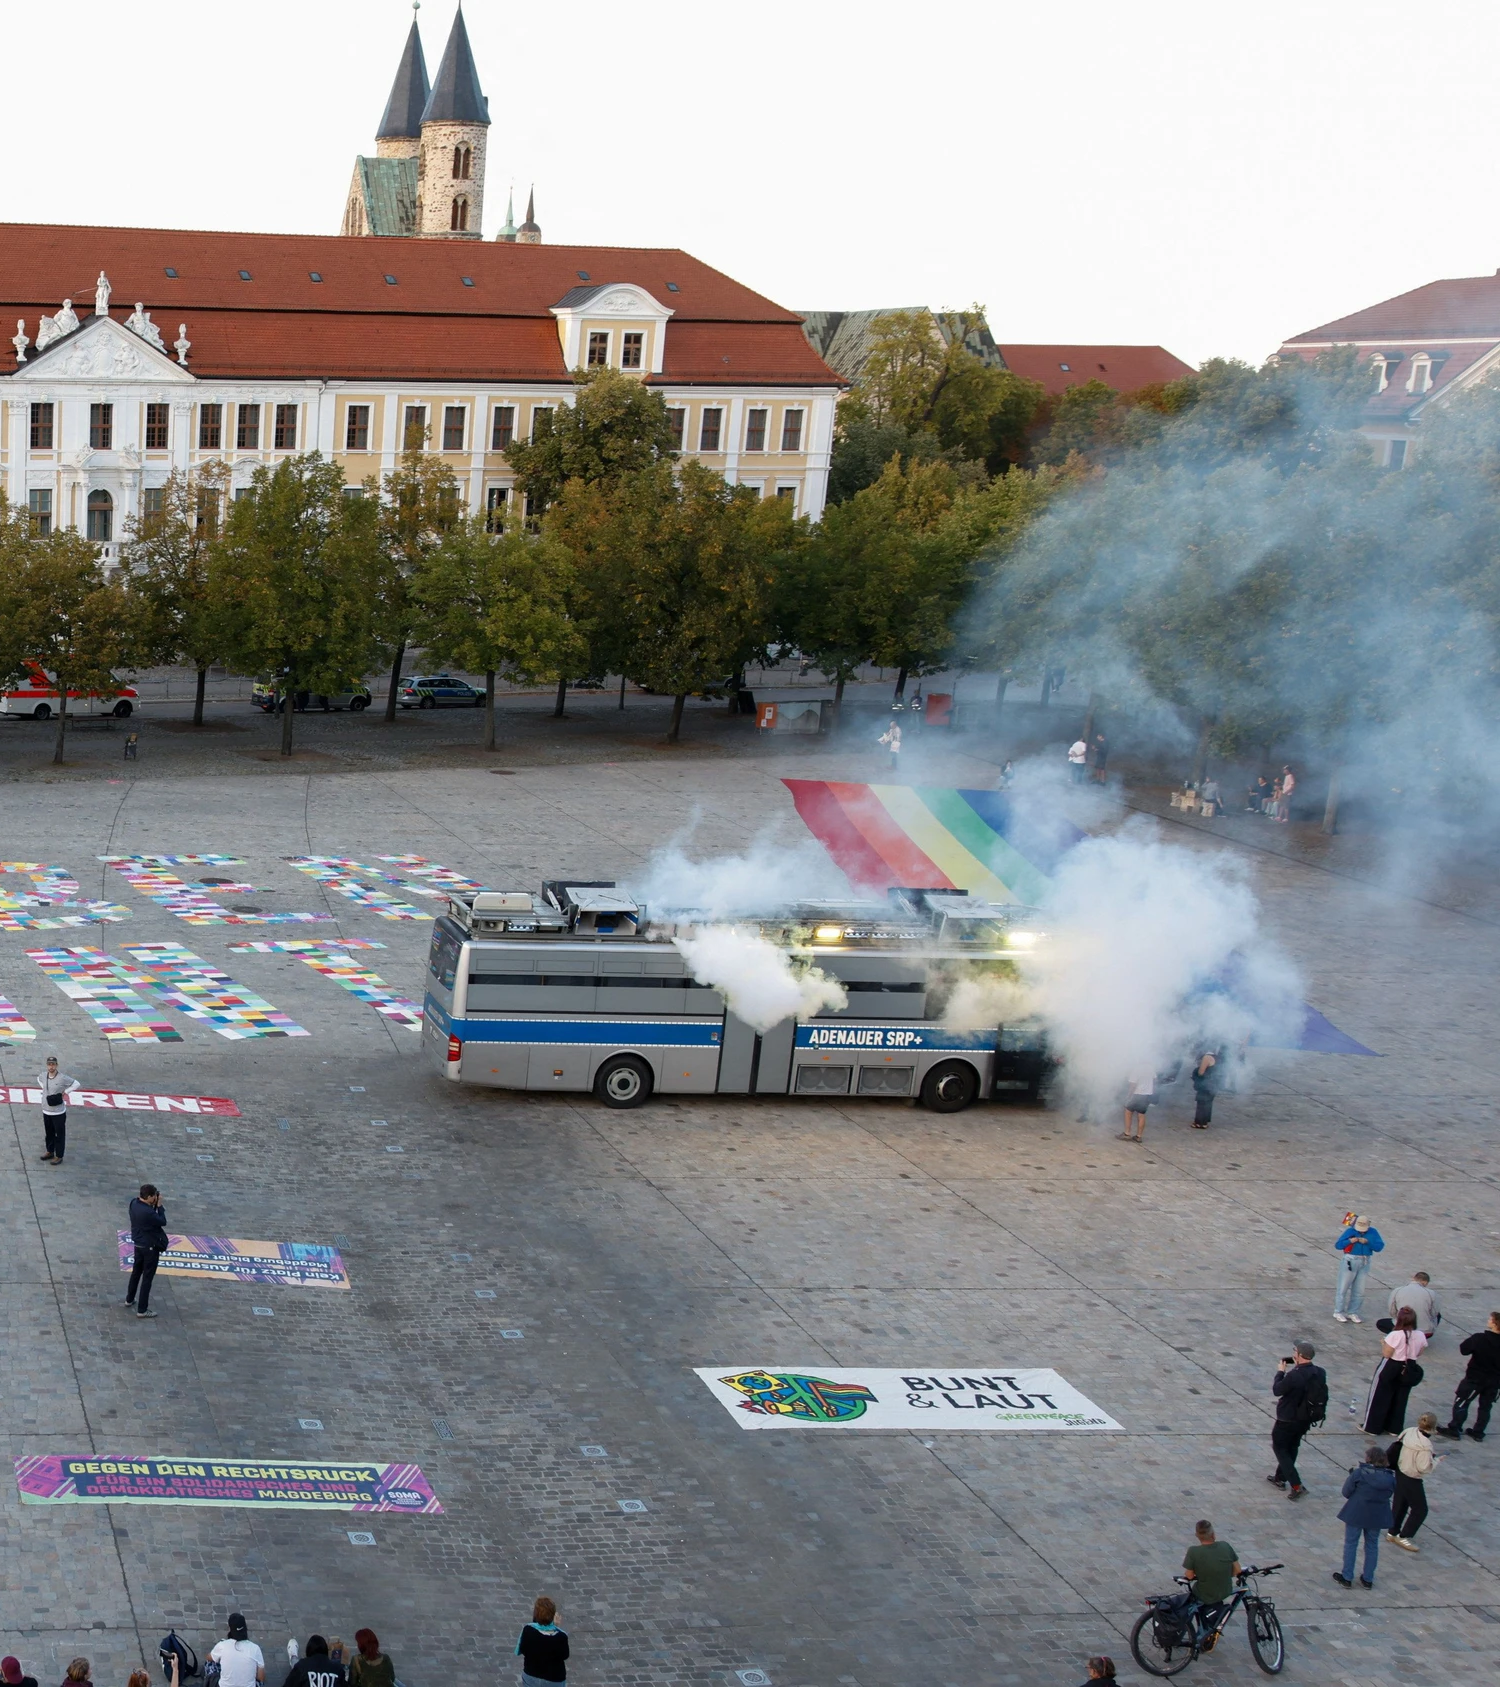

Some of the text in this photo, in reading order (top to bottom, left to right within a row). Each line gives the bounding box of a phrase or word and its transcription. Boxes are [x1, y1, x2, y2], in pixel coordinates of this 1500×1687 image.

[808, 1029, 923, 1046] ADENAUER SRP+
[212, 1254, 251, 1263] bleibt
[253, 1257, 328, 1269] Magdeburg
[234, 1266, 258, 1275] für
[261, 1267, 301, 1278] Platz
[304, 1271, 341, 1281] Kein
[900, 1376, 1021, 1391] BUNT
[906, 1393, 1059, 1409] & LAUT
[995, 1413, 1085, 1421] GREENPEACE
[68, 1462, 376, 1482] GEGEN DEN RECHTSRUCK
[95, 1474, 357, 1493] FÜR EIN SOLIDARISCHES UND
[87, 1485, 373, 1502] DEMOKRATISCHES MAGDEBURG
[388, 1491, 421, 1500] SOMA
[307, 1671, 339, 1687] RIOT
